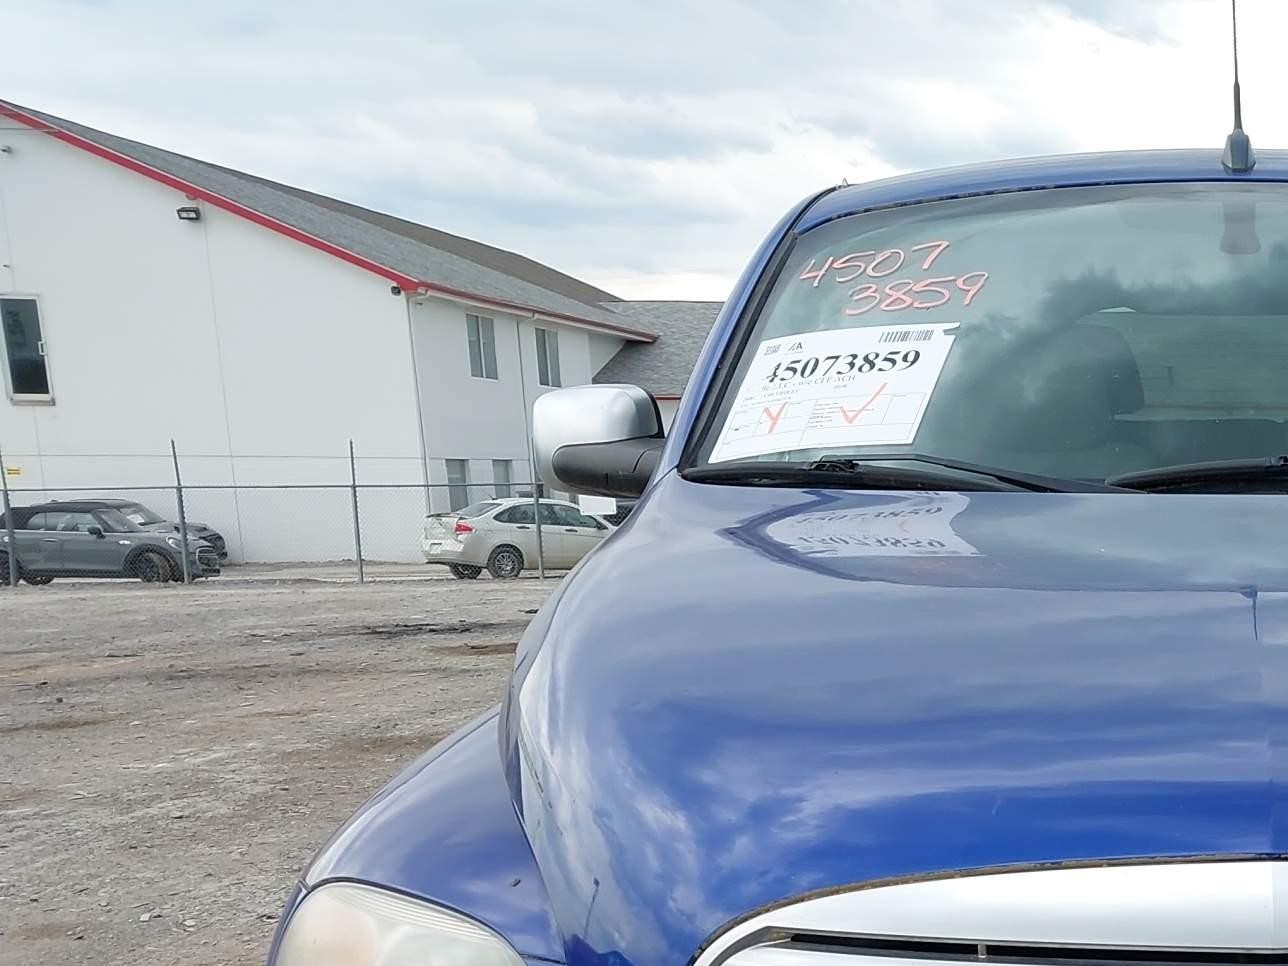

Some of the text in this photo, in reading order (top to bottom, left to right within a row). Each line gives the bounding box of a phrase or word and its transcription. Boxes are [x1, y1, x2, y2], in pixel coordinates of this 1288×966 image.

[799, 240, 950, 288] 4507
[845, 271, 990, 316] 3859
[765, 349, 921, 383] 45073859
